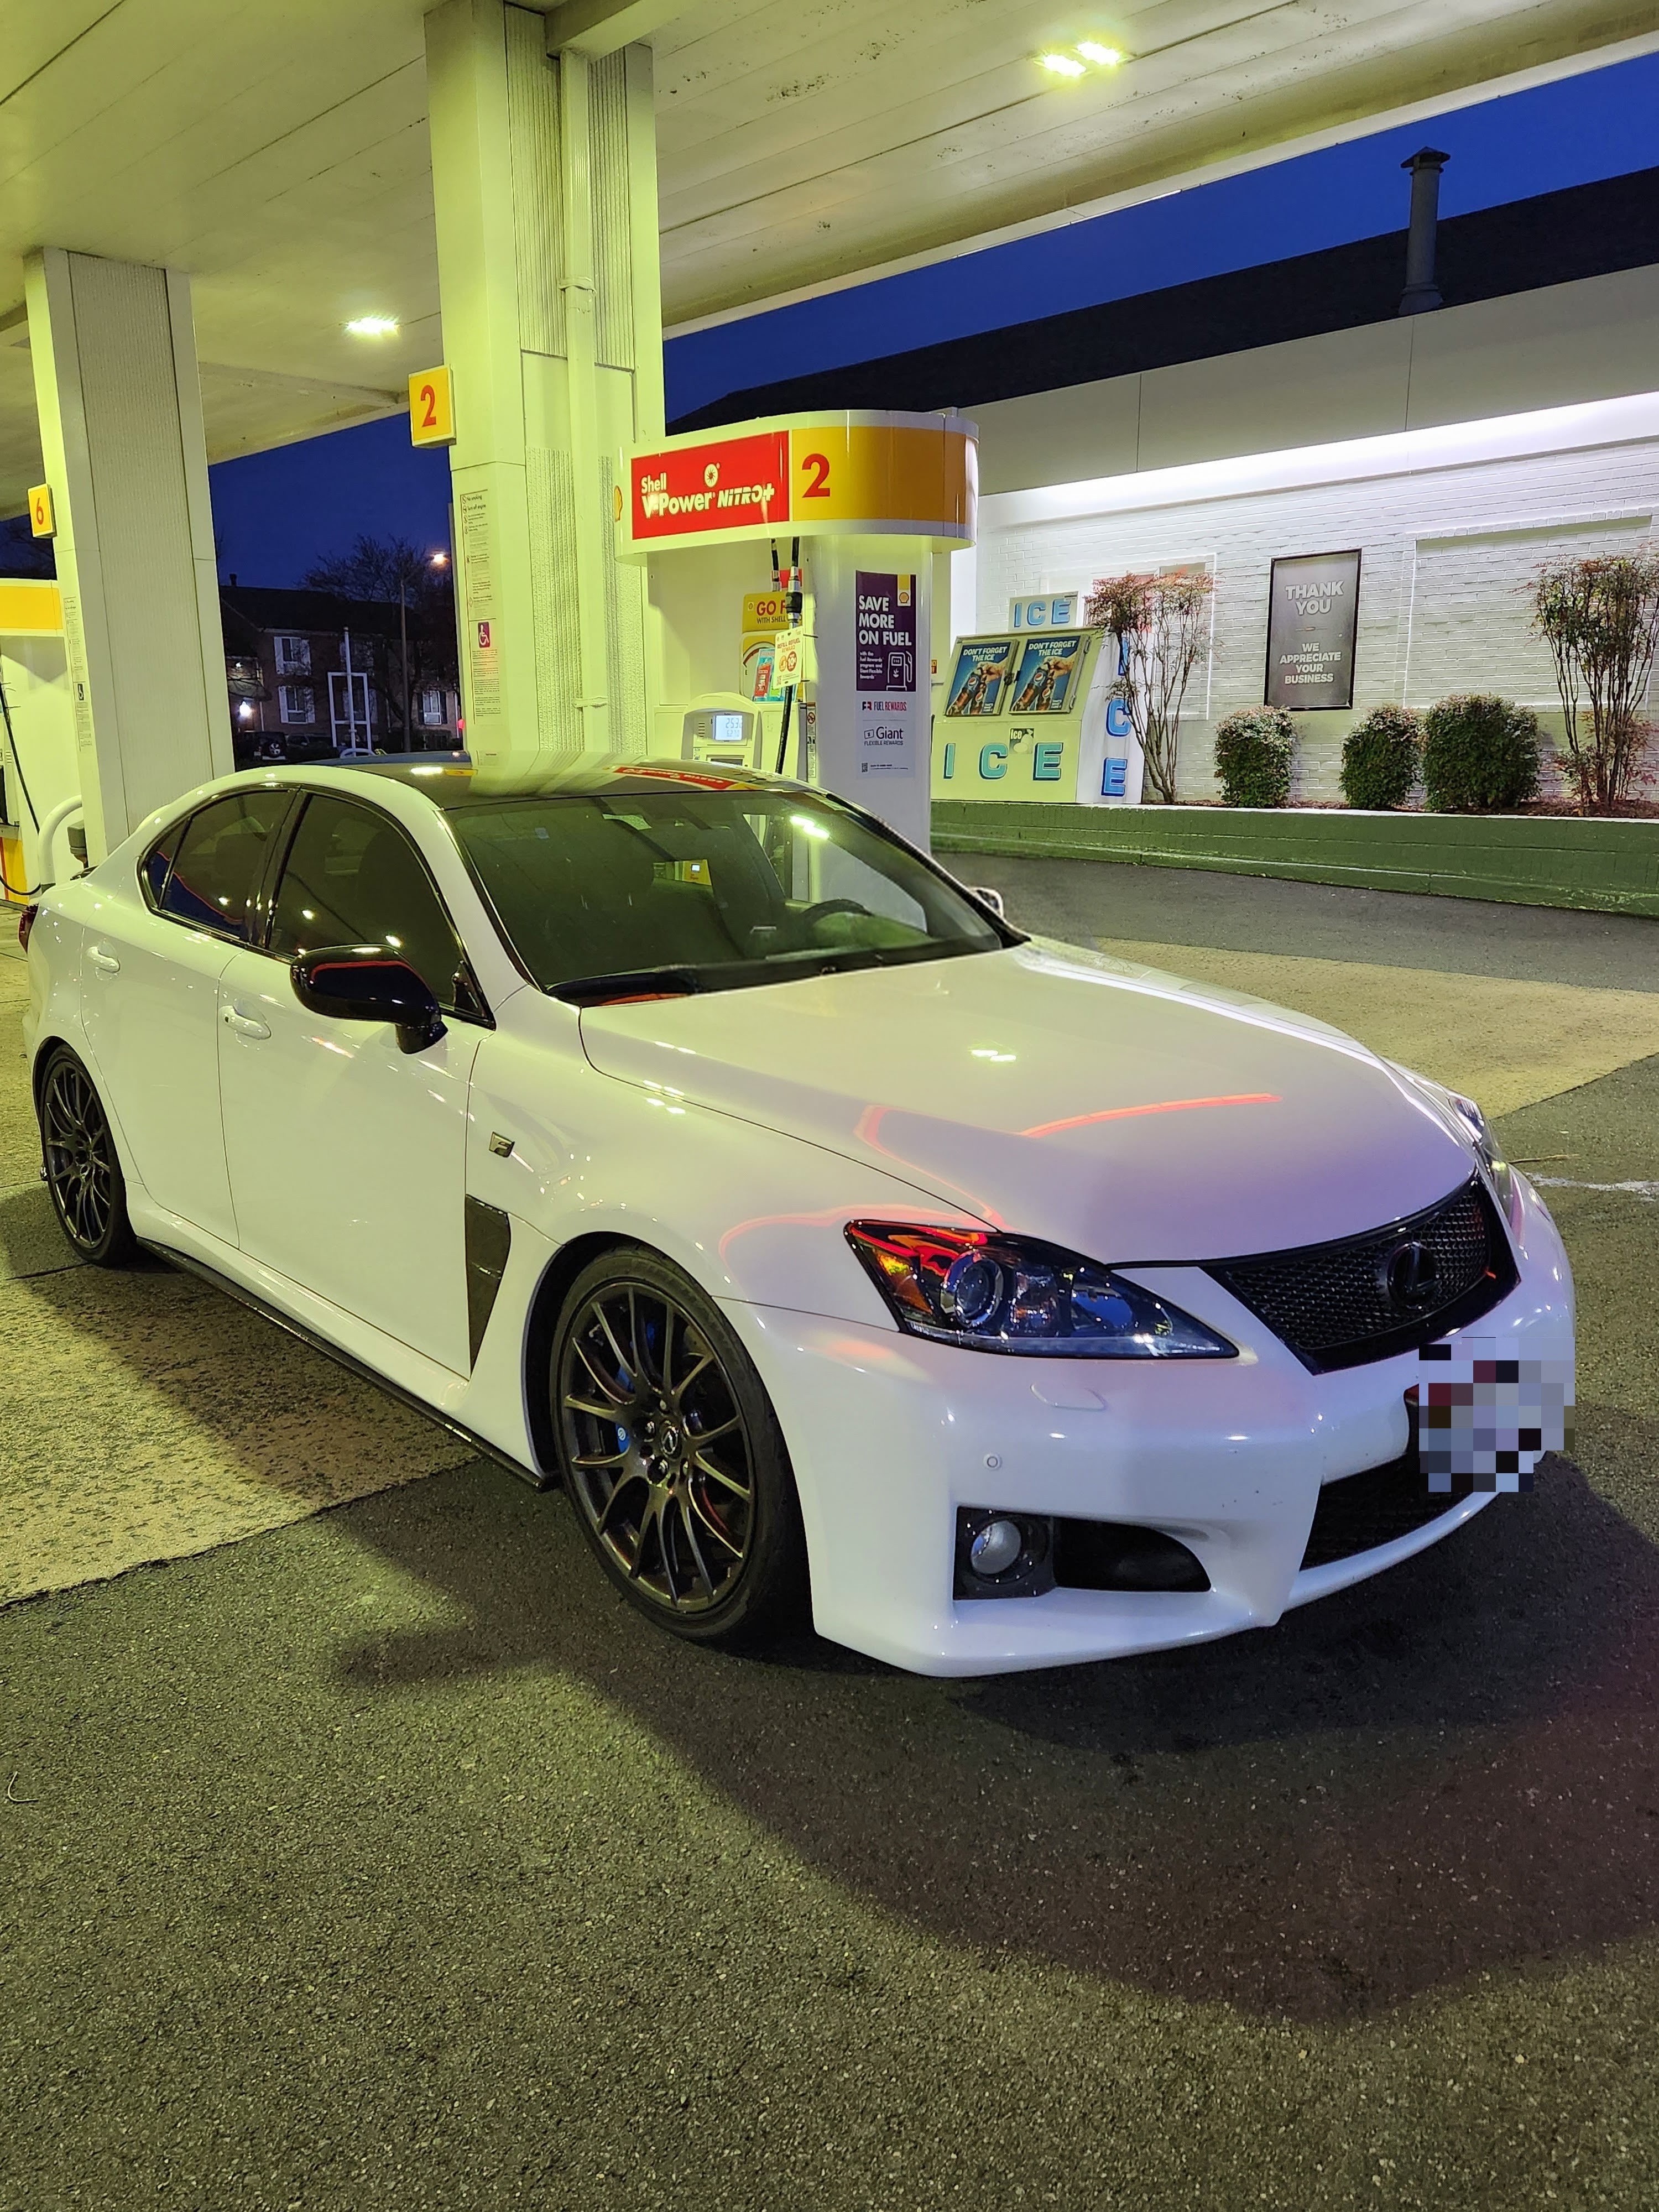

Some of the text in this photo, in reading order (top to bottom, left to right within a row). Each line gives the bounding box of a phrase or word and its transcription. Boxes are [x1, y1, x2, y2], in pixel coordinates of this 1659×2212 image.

[420, 385, 436, 427] 2
[641, 472, 667, 494] Shell
[802, 453, 831, 498] 2
[36, 497, 44, 525] 6
[1285, 581, 1344, 600] THANK
[757, 600, 776, 616] GO
[859, 594, 889, 612] SAVE
[1296, 598, 1332, 615] YOU
[859, 613, 895, 629] MORE
[1014, 599, 1071, 628] ICE
[859, 630, 912, 646] ON FUEL
[1029, 640, 1077, 650] DON'T FORGET
[963, 646, 1008, 655] DON'T FORGET
[1302, 642, 1319, 653] WE
[1280, 651, 1341, 664] APPRECIATE
[1296, 664, 1324, 673] YOUR
[1285, 673, 1334, 684] BUSINESS
[874, 701, 884, 711] FUEL
[885, 701, 907, 711] REWARDS
[876, 726, 904, 739] Giant
[943, 742, 1063, 781] ICE
